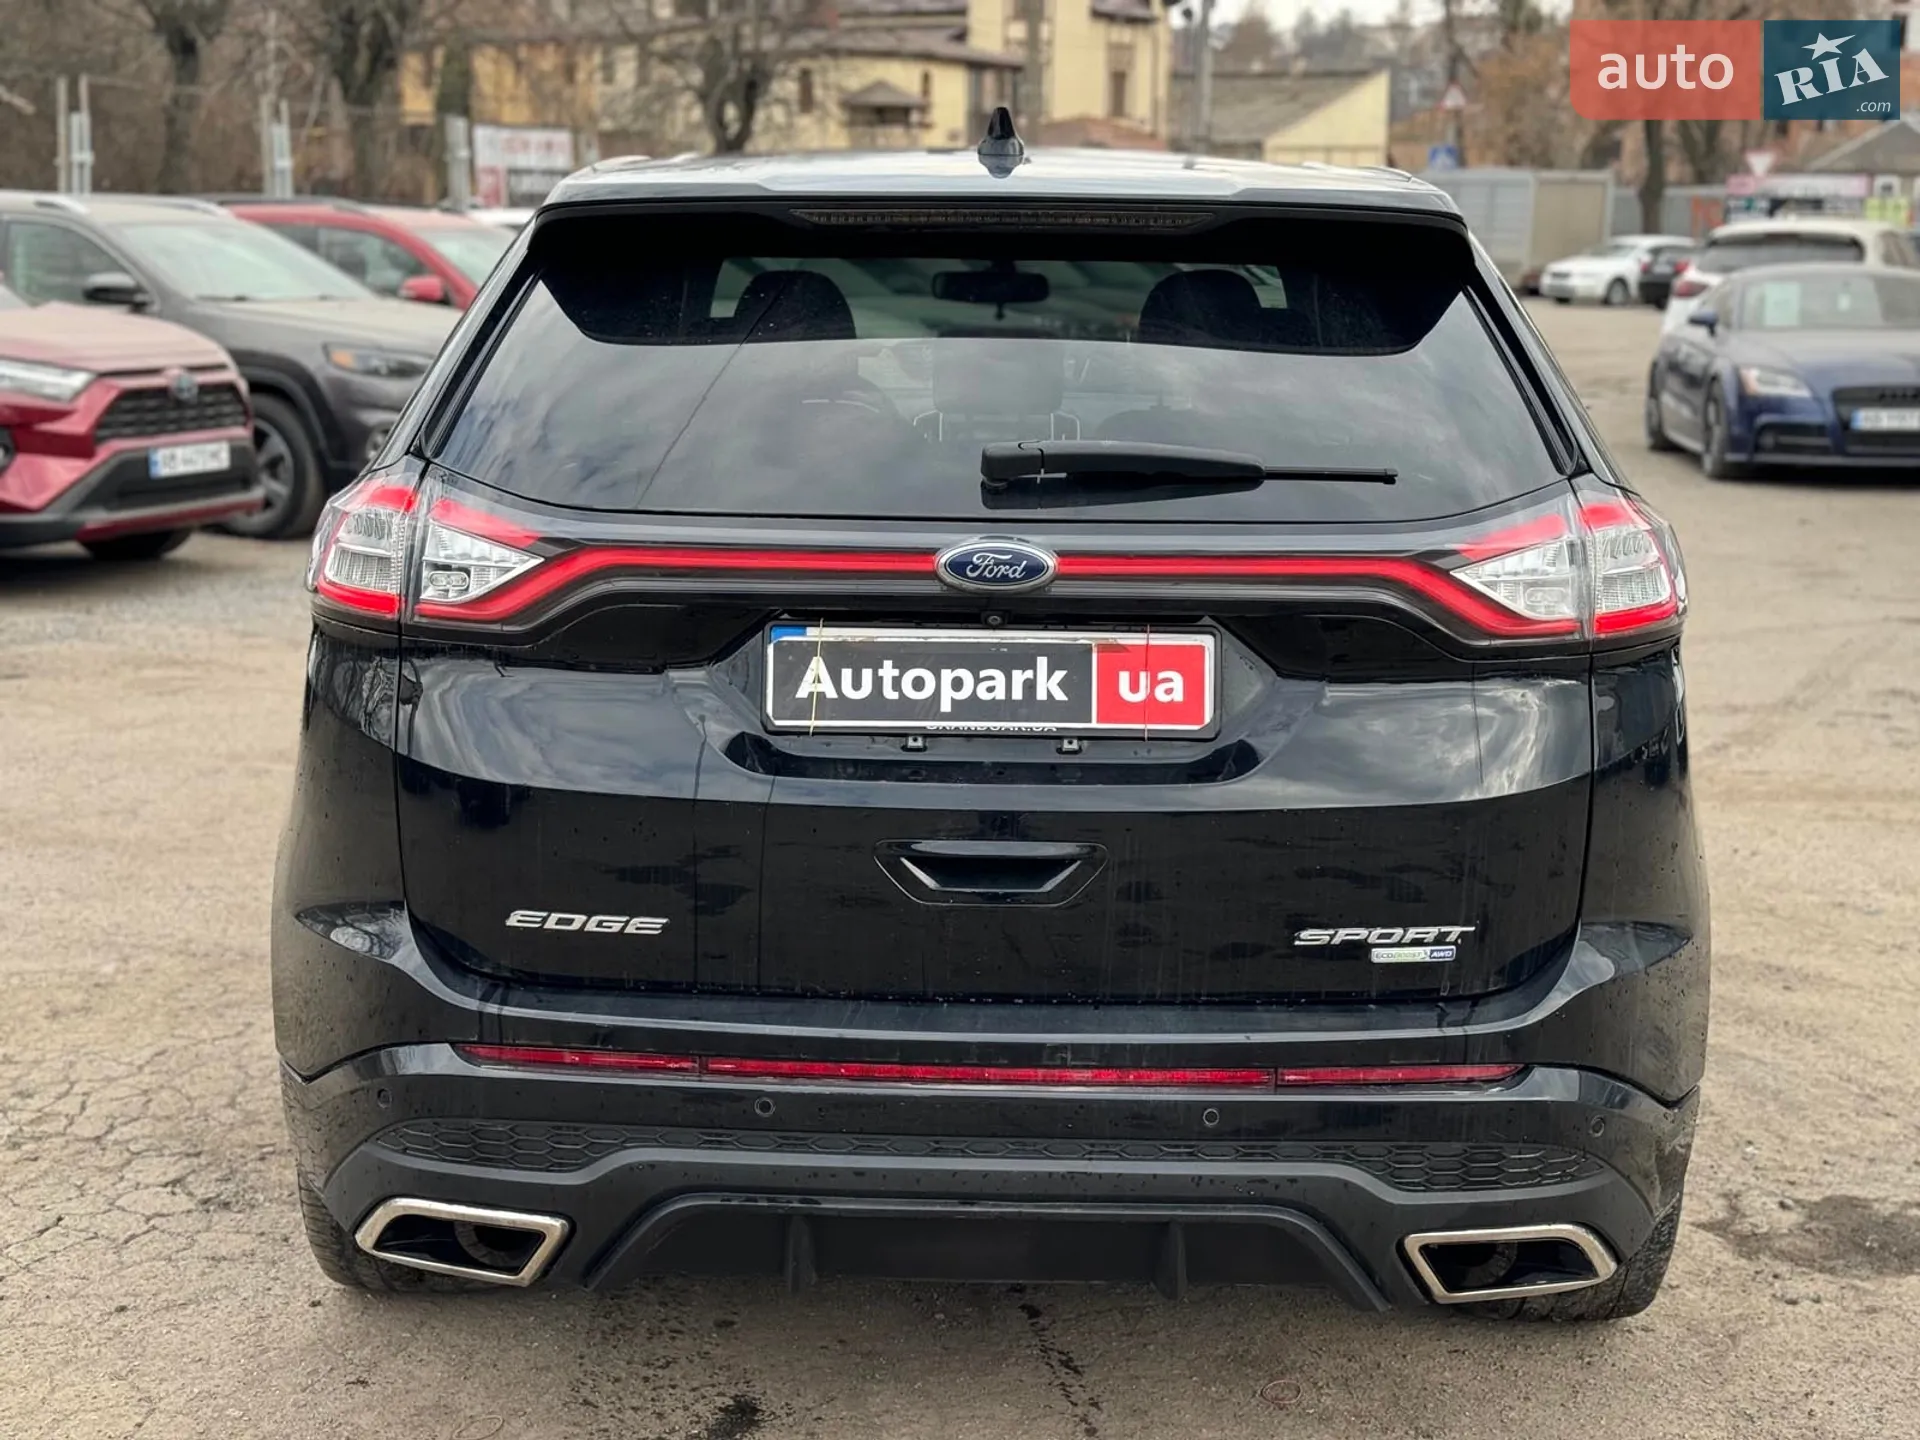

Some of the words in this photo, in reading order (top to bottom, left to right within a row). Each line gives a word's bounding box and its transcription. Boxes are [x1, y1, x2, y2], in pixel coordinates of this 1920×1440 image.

[966, 552, 1028, 579] Ford
[795, 656, 1068, 712] Autopark
[1118, 669, 1184, 703] ua
[505, 909, 670, 935] EDGE
[1294, 926, 1476, 945] SPORT
[1430, 950, 1453, 958] AWD
